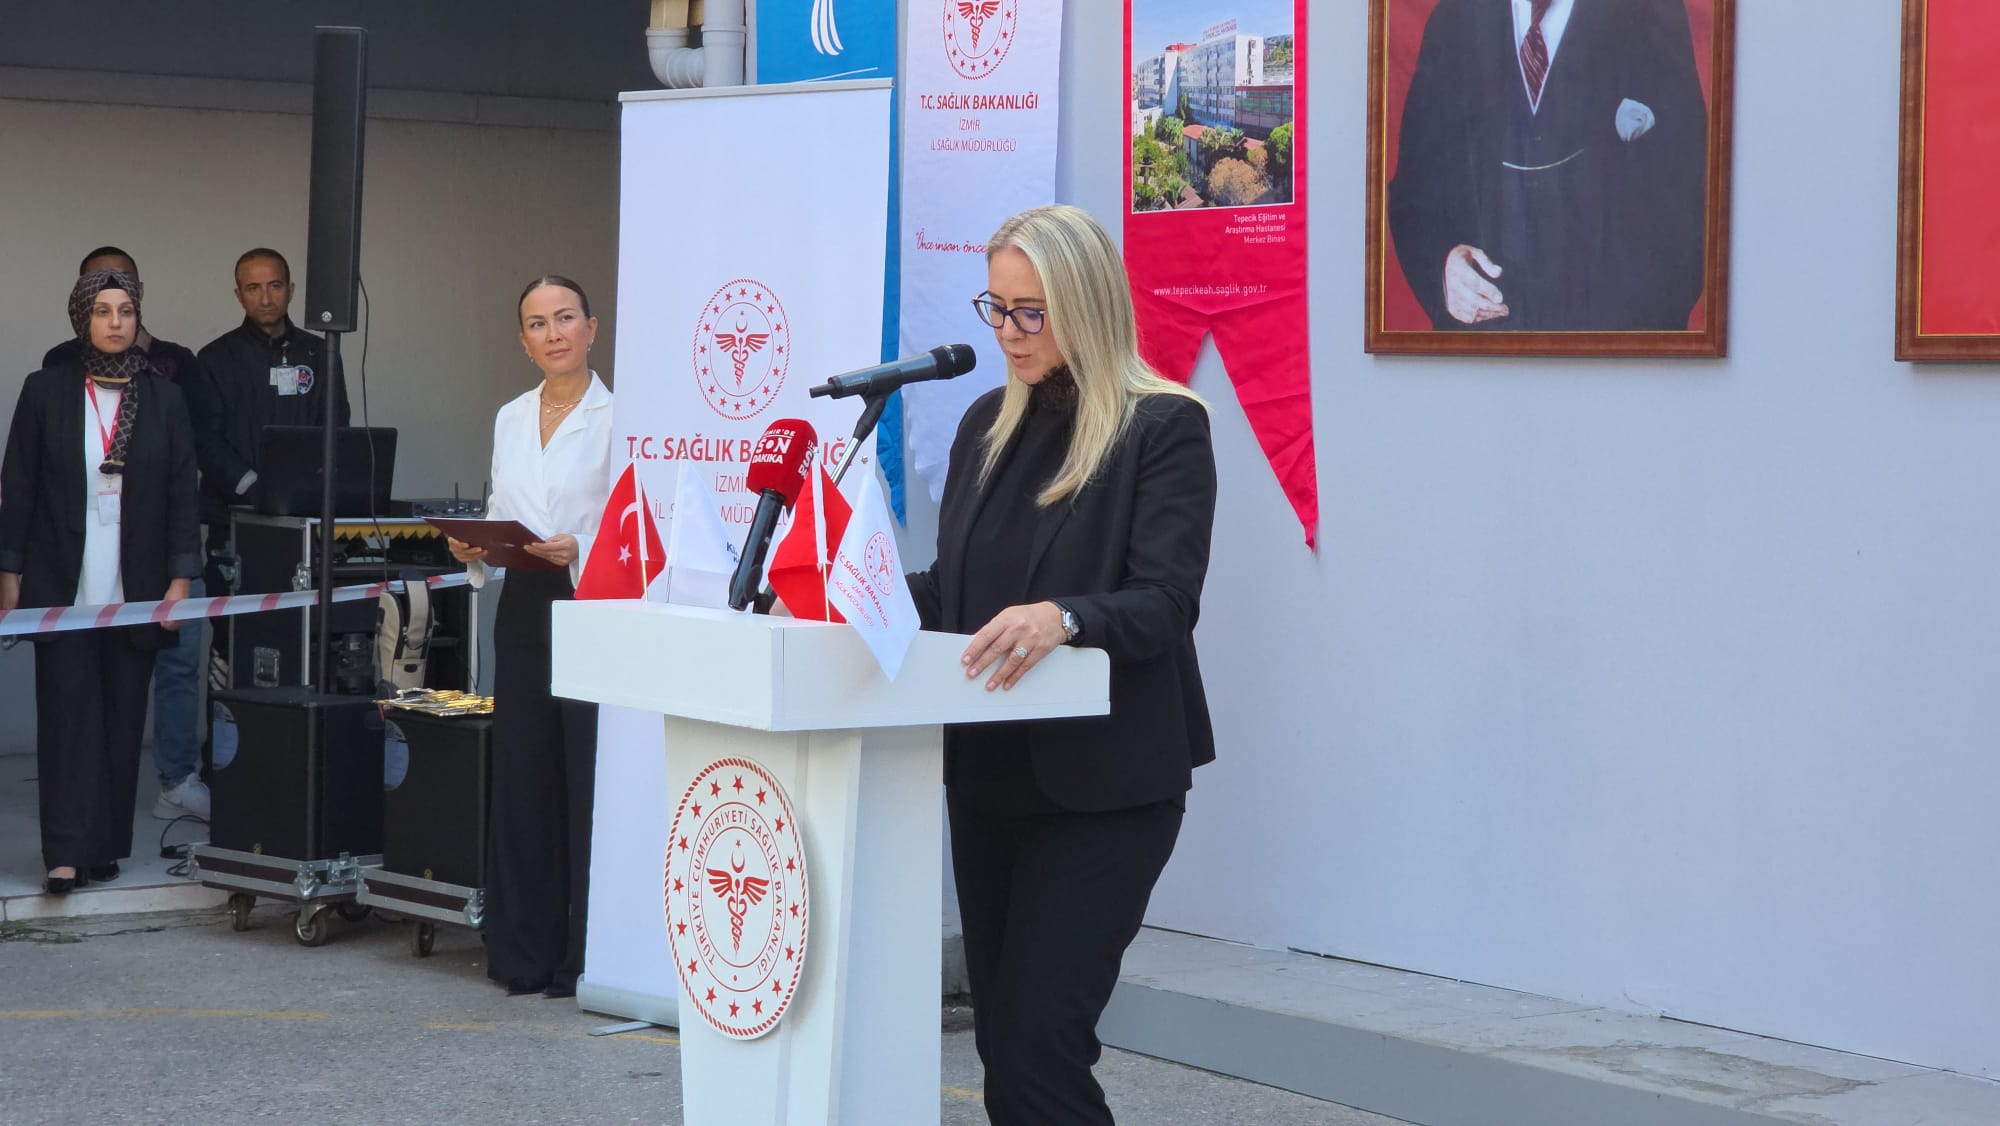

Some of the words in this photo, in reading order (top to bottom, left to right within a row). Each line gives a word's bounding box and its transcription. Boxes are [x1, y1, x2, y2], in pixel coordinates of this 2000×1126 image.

[921, 95, 935, 110] T.C.
[937, 92, 970, 110] SAĞLIK
[972, 91, 1038, 110] BAKANLIĞI
[937, 138, 959, 151] SAĞLIK
[961, 137, 1017, 152] MÜDÜRLÜĞÜ
[1225, 224, 1255, 234] Araştırma
[1256, 222, 1286, 233] Hastanesi
[1233, 214, 1257, 225] Tepecik
[1257, 213, 1278, 224] Eğitim
[1243, 235, 1266, 244] Merkez
[1267, 234, 1286, 244] Binası
[1153, 283, 1268, 298] www.tepecikeah.saglik.gov.tr
[663, 433, 734, 462] SAĞLIK
[756, 437, 792, 455] SON
[655, 499, 665, 519] İL
[844, 560, 867, 586] SAĞLIK
[693, 808, 748, 883] CUMHURİYETİ
[750, 818, 779, 873] SAĞLIK
[692, 890, 716, 966] TÜRKİYE
[756, 880, 782, 976] BAKANLIĞI
